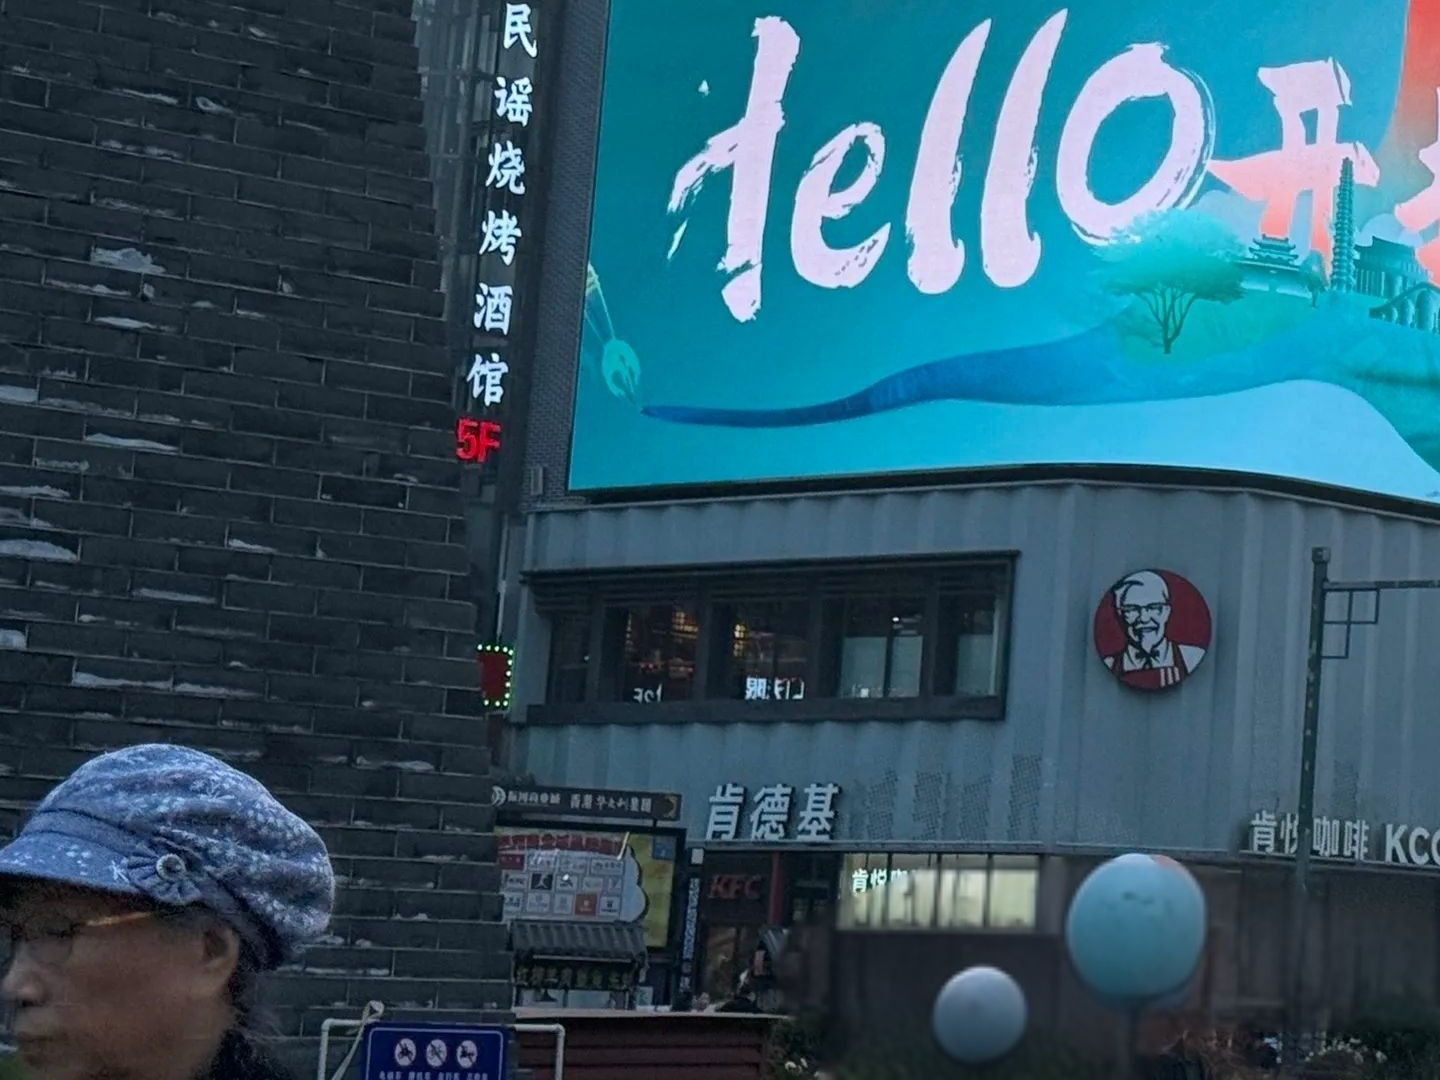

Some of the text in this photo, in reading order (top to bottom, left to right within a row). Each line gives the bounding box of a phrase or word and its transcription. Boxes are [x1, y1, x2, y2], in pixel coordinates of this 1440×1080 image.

[455, 418, 500, 462] 5F
[705, 782, 841, 843] 肯德基
